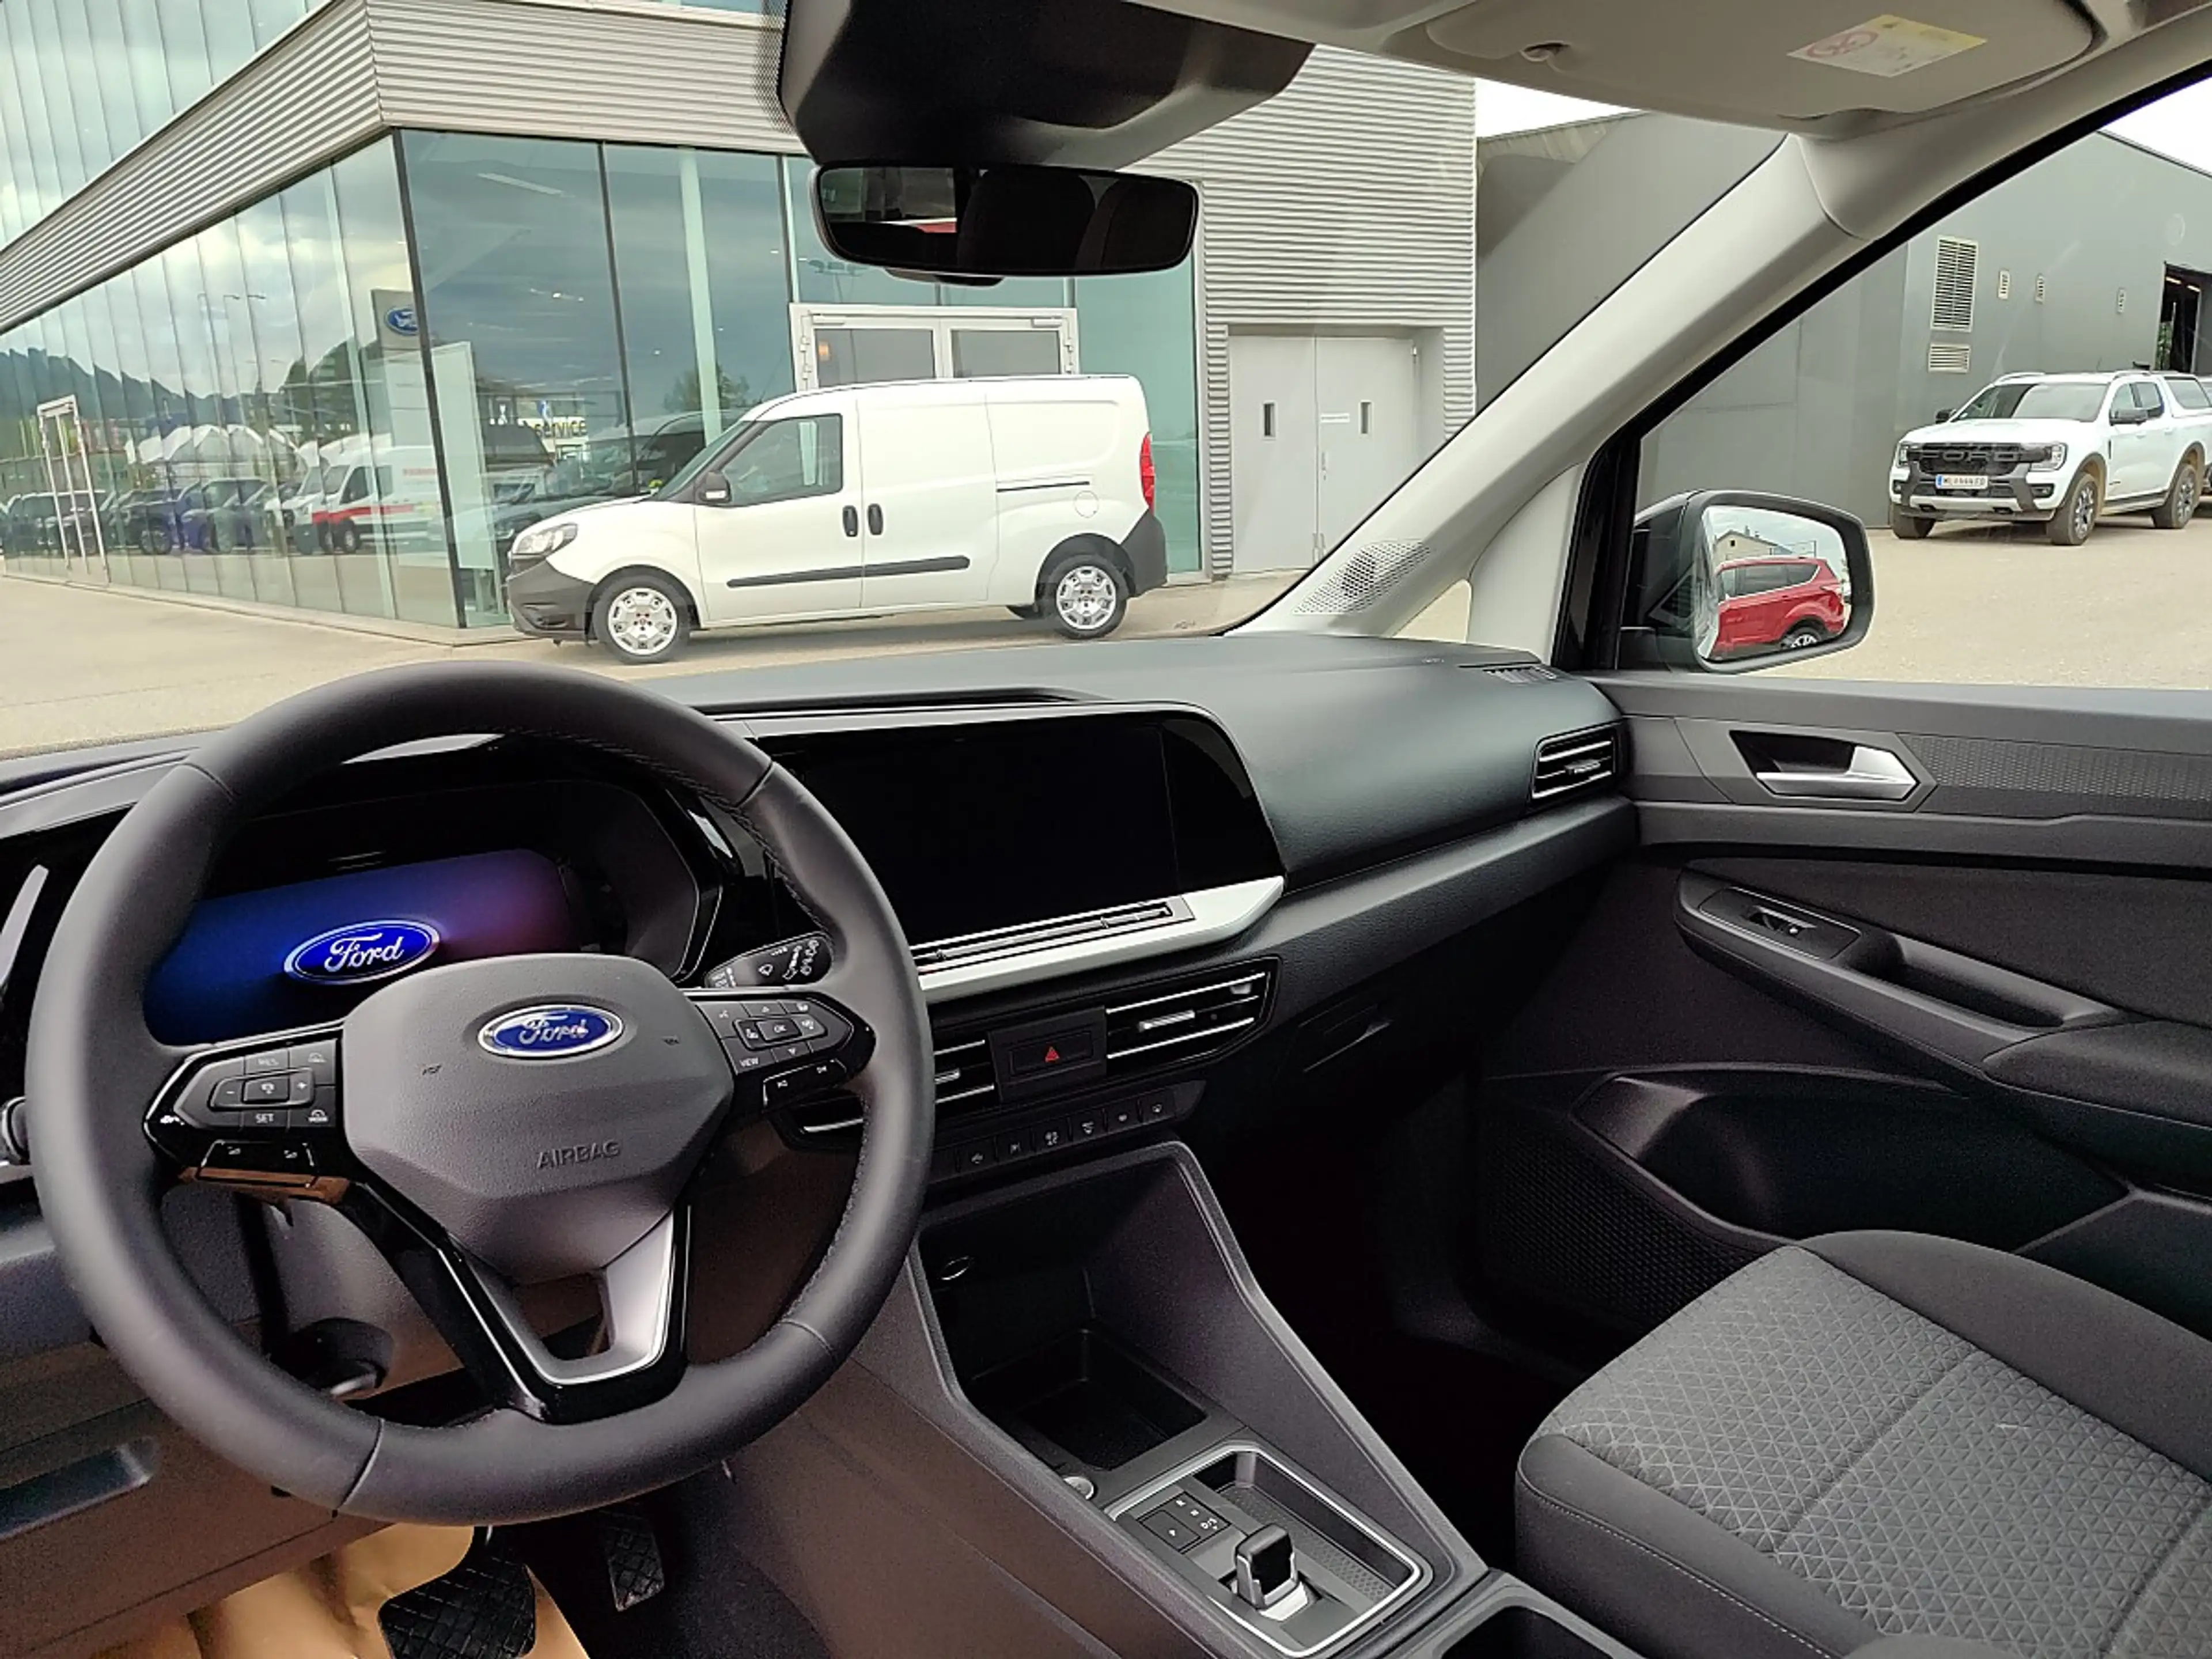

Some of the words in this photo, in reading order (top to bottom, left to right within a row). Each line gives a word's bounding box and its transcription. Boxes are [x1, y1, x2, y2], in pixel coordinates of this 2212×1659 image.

[1919, 450, 2019, 462] FORD
[324, 933, 404, 972] Ford
[519, 1014, 589, 1044] Ford
[255, 1112, 274, 1124] SET
[536, 1139, 620, 1169] AIRBAG
